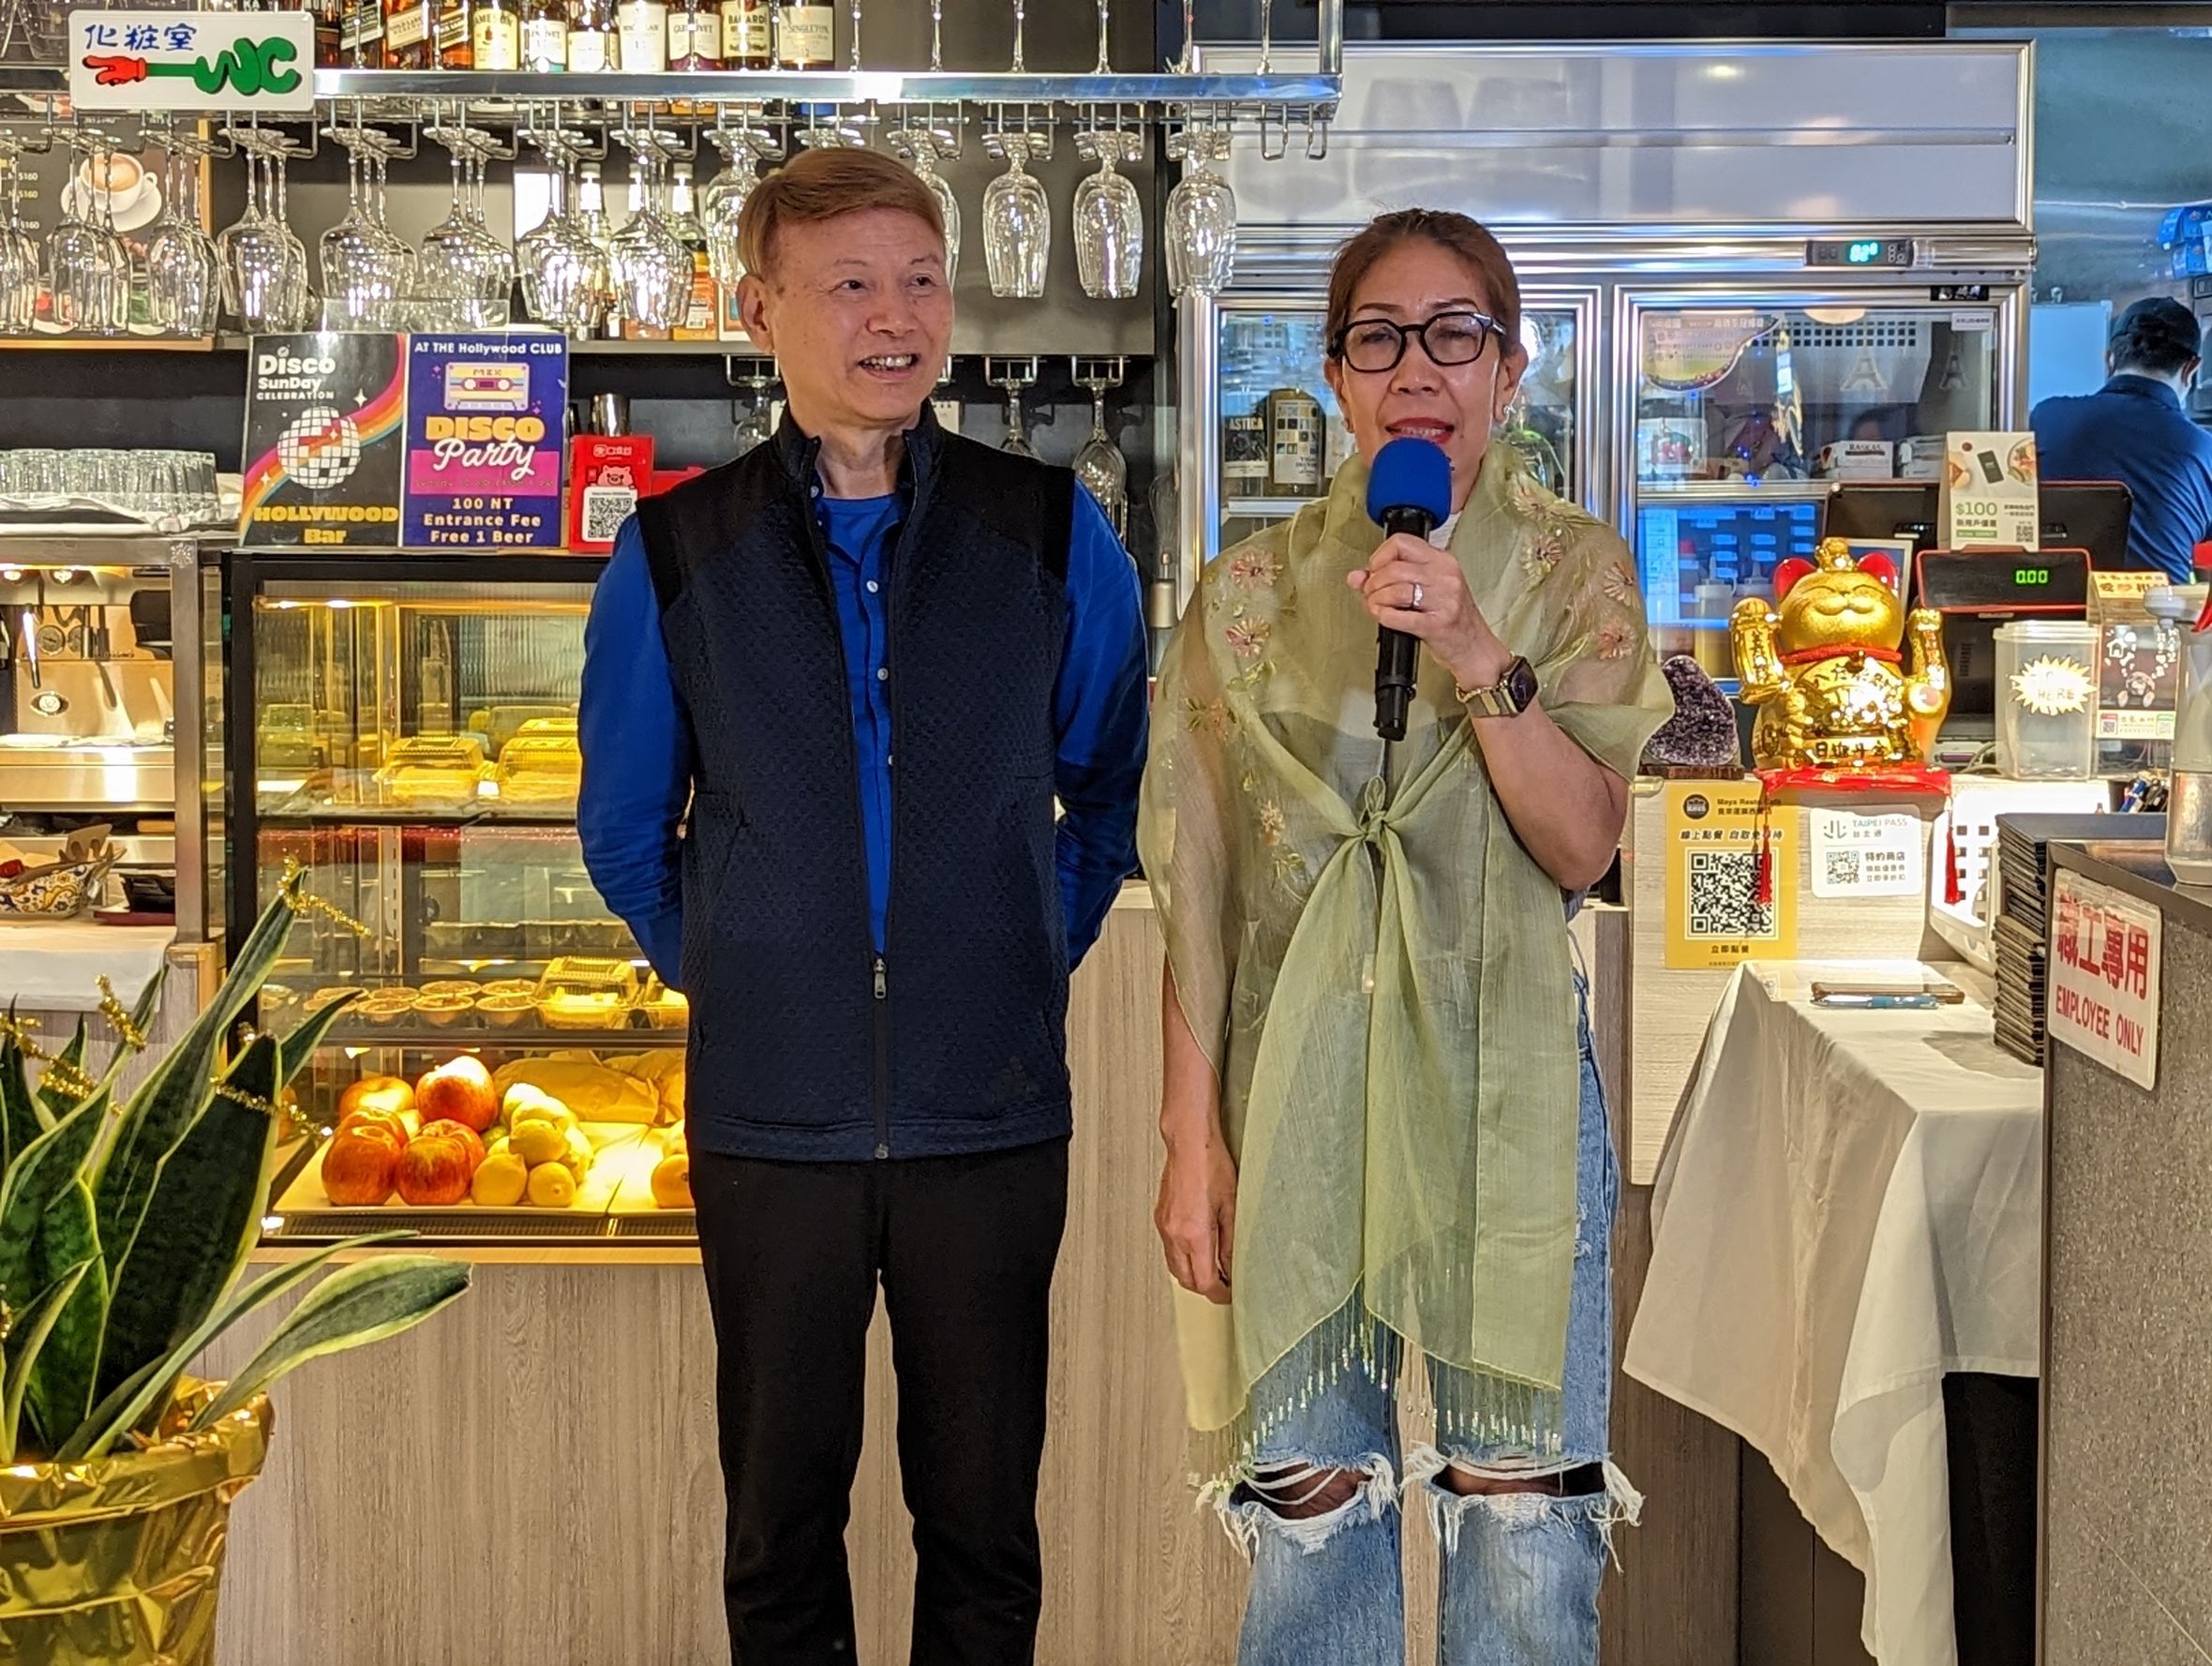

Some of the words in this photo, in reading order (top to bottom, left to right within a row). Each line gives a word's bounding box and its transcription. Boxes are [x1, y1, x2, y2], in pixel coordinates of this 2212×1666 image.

[728, 14, 768, 25] BAARDI
[84, 23, 197, 52] 化粧室
[194, 37, 303, 97] WC
[414, 341, 428, 353] AT
[432, 341, 455, 354] THE
[458, 342, 527, 356] Hollywood
[530, 341, 562, 354] CLUB
[258, 353, 336, 375] Disco
[258, 377, 322, 392] SunDay
[256, 391, 335, 400] CELEBRATION
[425, 415, 546, 443] DISCO
[432, 435, 536, 480] Party
[452, 497, 484, 509] 100
[490, 497, 514, 510] NT
[1955, 502, 1998, 517] $100
[253, 506, 399, 522] HOLLYWOOD
[423, 514, 504, 526] Entrance
[510, 514, 542, 527] Fee
[304, 528, 347, 544] Bar
[430, 530, 470, 544] Free
[476, 531, 486, 543] 1
[491, 531, 534, 544] Beer
[1852, 818, 1882, 828] TAIPEI
[1884, 818, 1908, 827] PASS
[1728, 830, 1783, 841] 自取免待
[1711, 944, 1750, 954] 立即點餐
[2055, 892, 2149, 1000] 職工專用
[2055, 984, 2110, 1041] EMPLOYEE
[2115, 1013, 2145, 1057] ONLY
